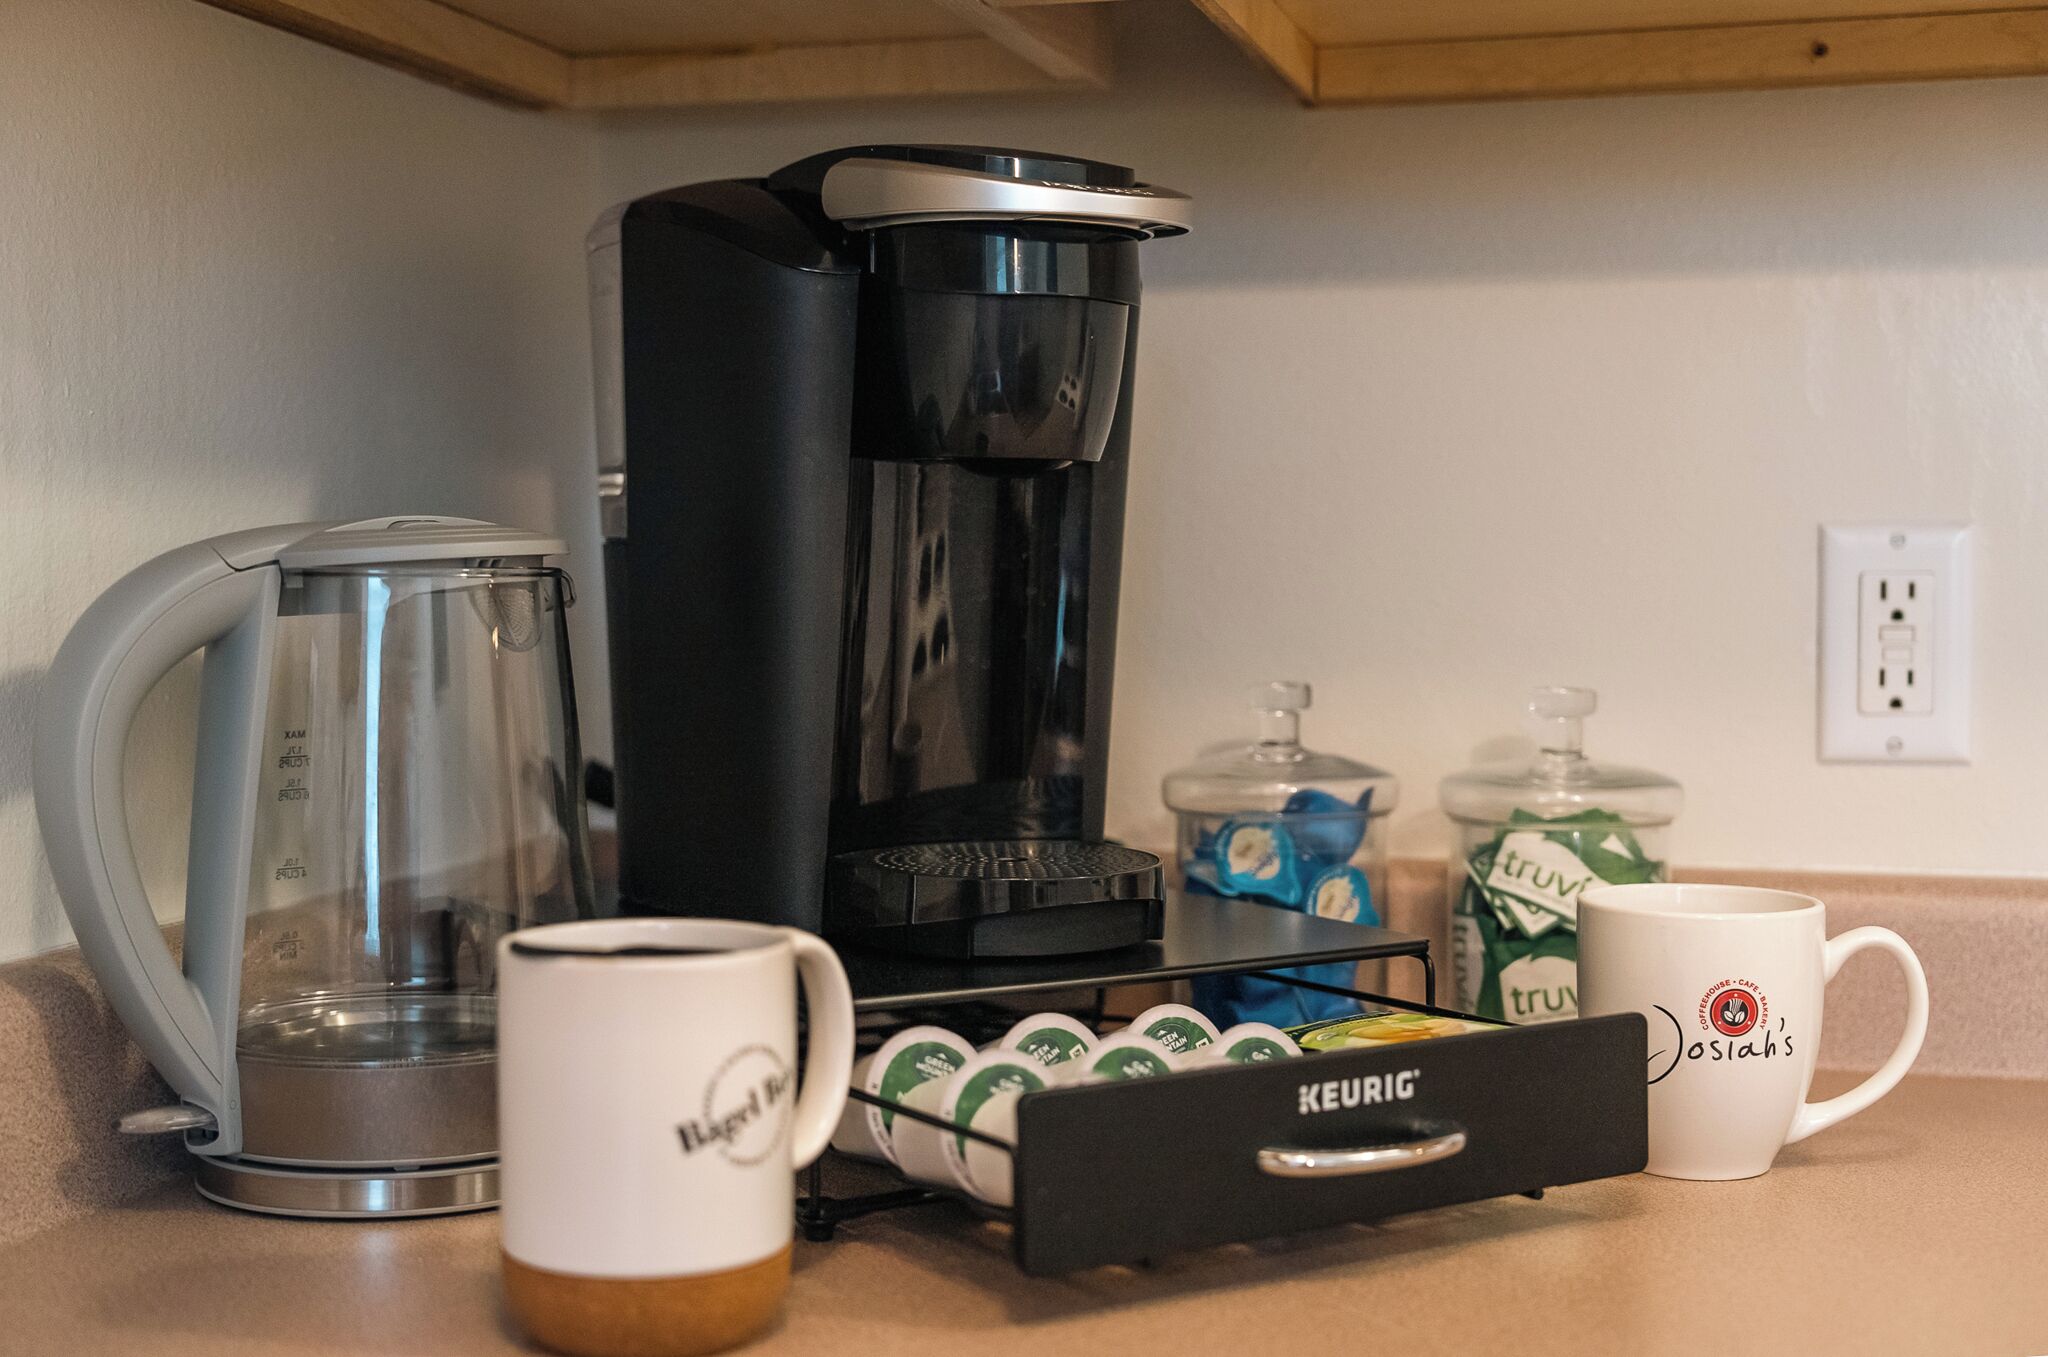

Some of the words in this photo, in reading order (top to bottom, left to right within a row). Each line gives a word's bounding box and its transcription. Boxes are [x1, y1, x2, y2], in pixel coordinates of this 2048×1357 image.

[1504, 850, 1593, 897] truvi
[1698, 979, 1731, 1031] COFFEEHOUSE
[1738, 979, 1760, 993] CAFE
[1759, 995, 1769, 1030] BAKERY
[1299, 1069, 1416, 1115] KEURIG
